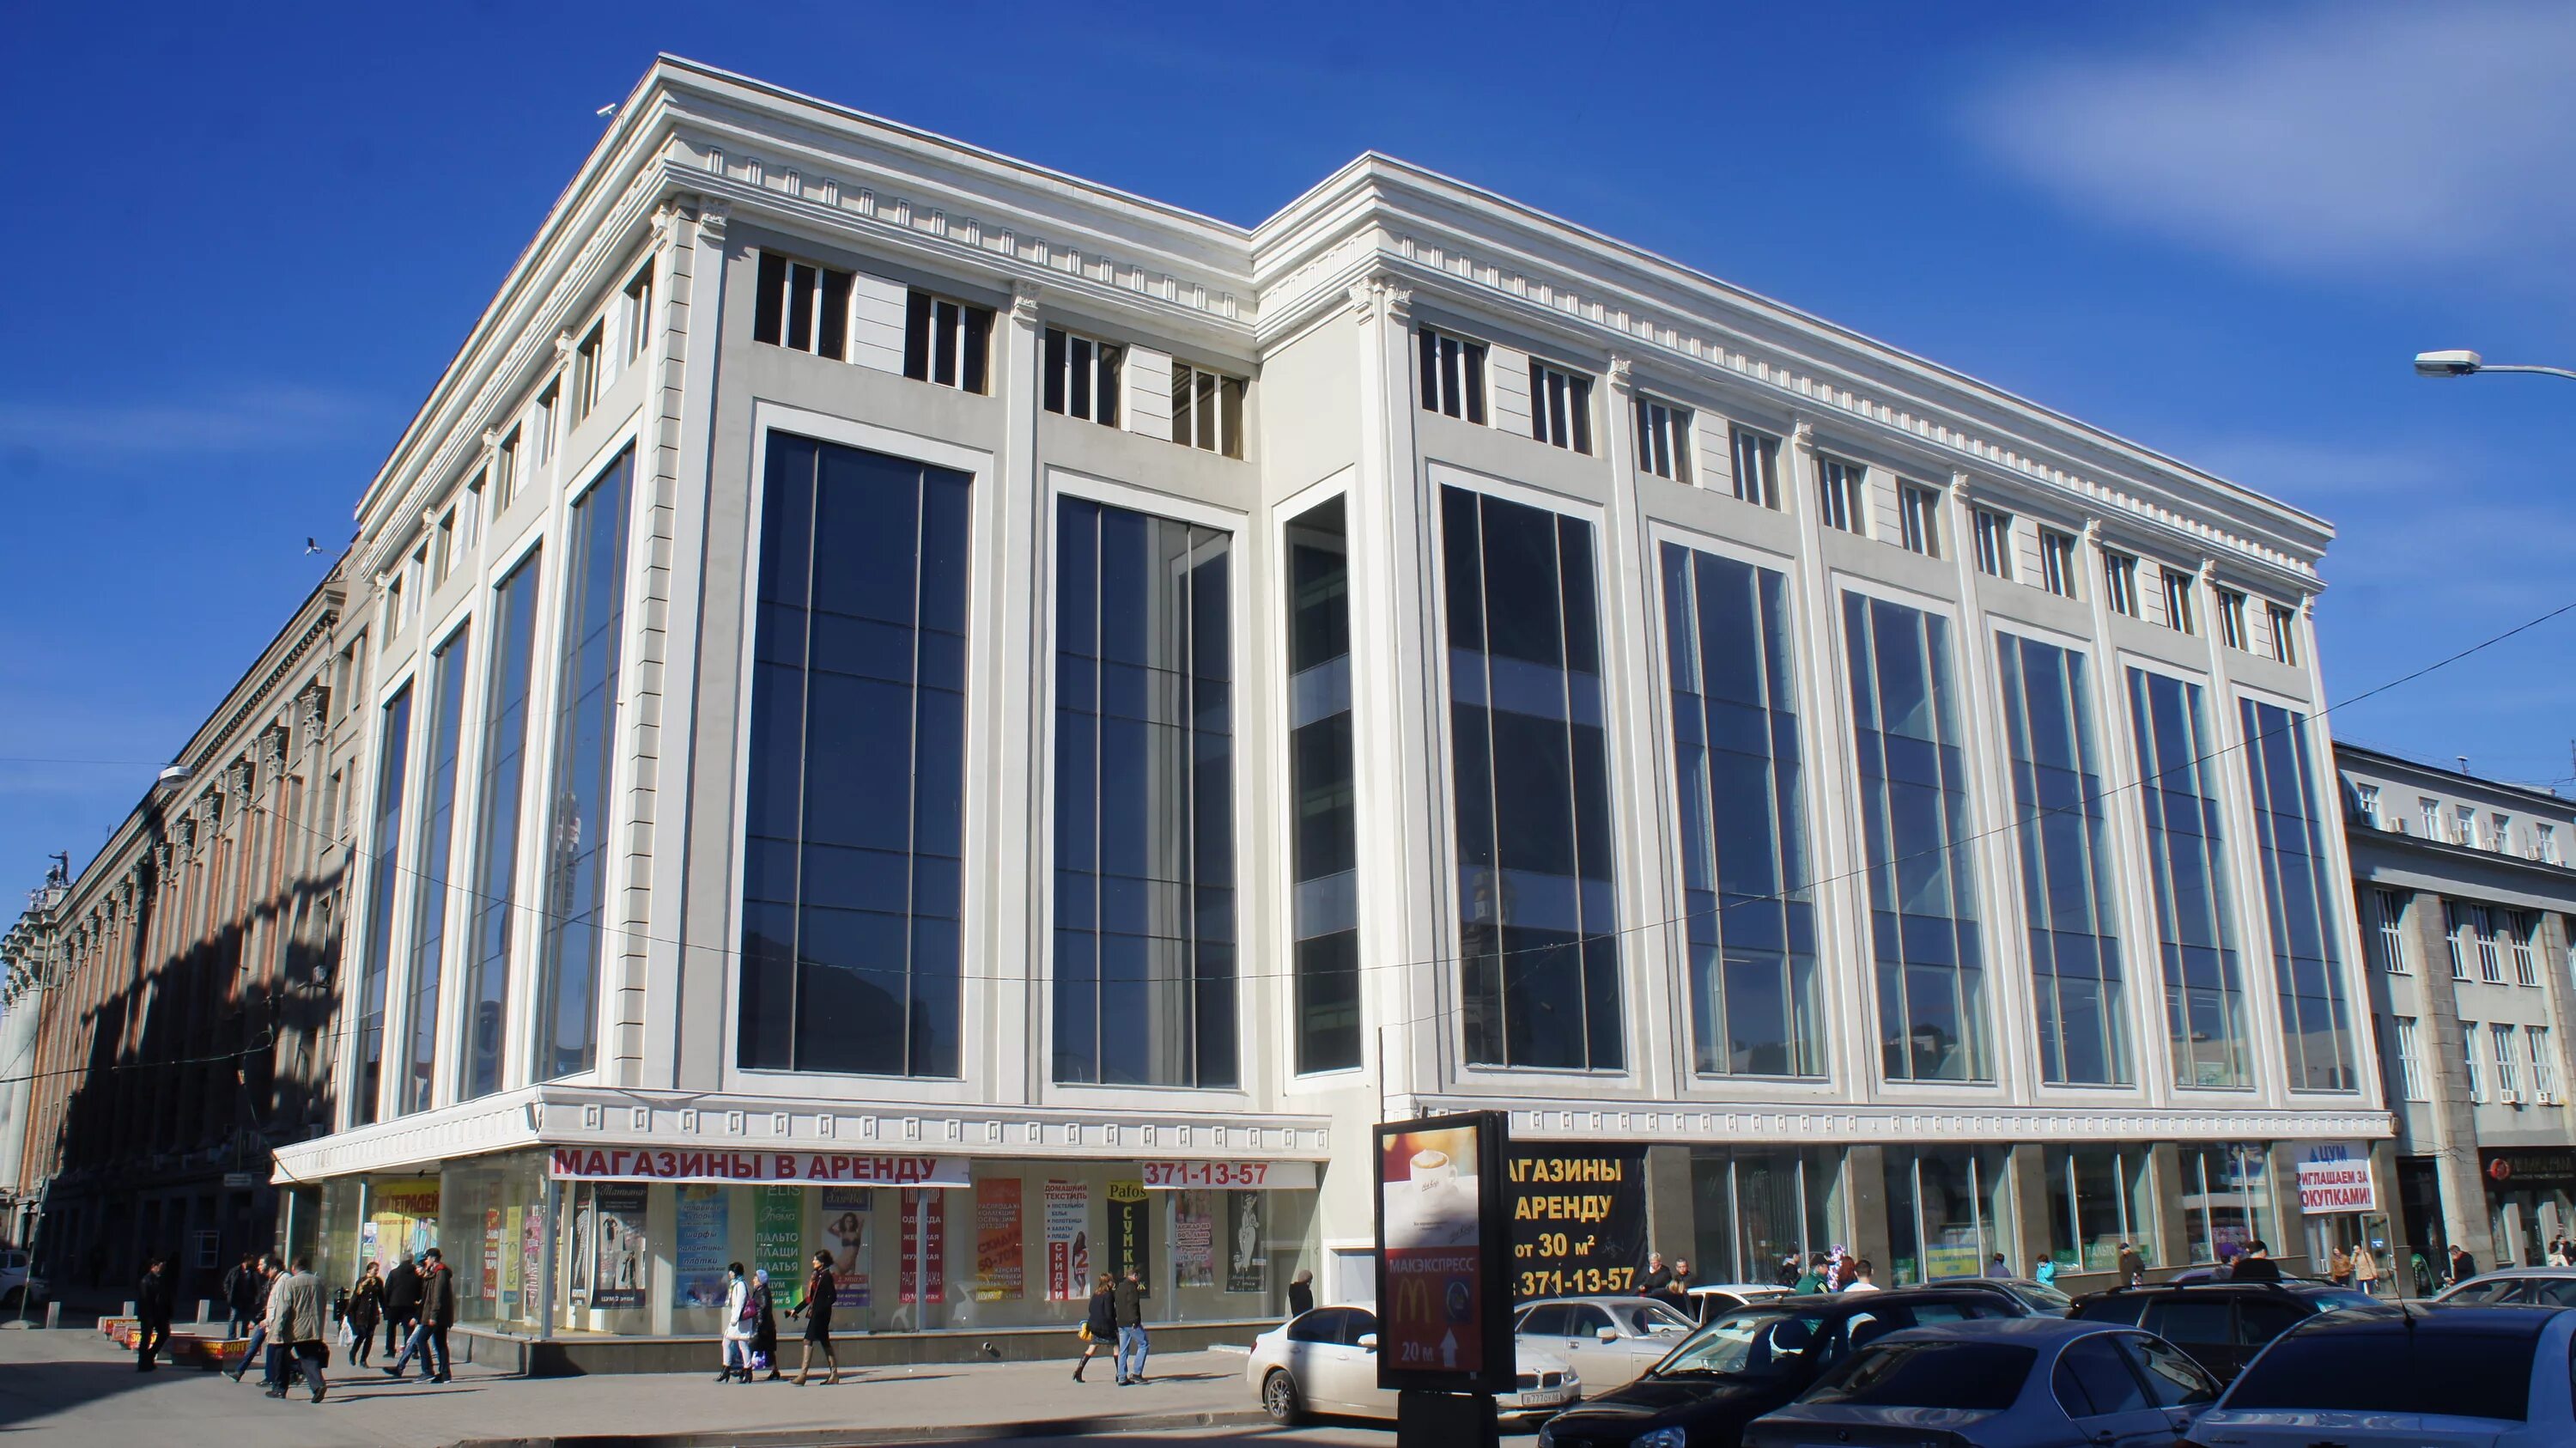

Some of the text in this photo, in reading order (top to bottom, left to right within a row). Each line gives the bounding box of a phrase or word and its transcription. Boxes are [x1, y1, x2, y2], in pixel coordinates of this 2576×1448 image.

[2319, 1146, 2347, 1165] ЦУМ
[554, 1149, 937, 1184] МАГАЗИНЫ В АРЕНДУ
[1144, 1162, 1267, 1184] 371-13-57
[2356, 1171, 2368, 1183] ЗА
[1045, 1185, 1087, 1194] ДОМАШНИЙ
[1109, 1184, 1146, 1198] Pafos
[1515, 1195, 1613, 1223] АРЕНДУ
[756, 1232, 799, 1243] ПАЛЬТО
[1515, 1244, 1533, 1257] от
[1539, 1232, 1567, 1256] 30
[756, 1248, 798, 1257] ПЛАЩИ
[756, 1262, 798, 1271] ПЛАТЬЯ
[1054, 1244, 1064, 1299] СКИДКИ
[1389, 1257, 1476, 1274] МАКЭКСПРЕСС
[1521, 1267, 1635, 1295] 371-13-57
[1401, 1341, 1434, 1361] 20 м
